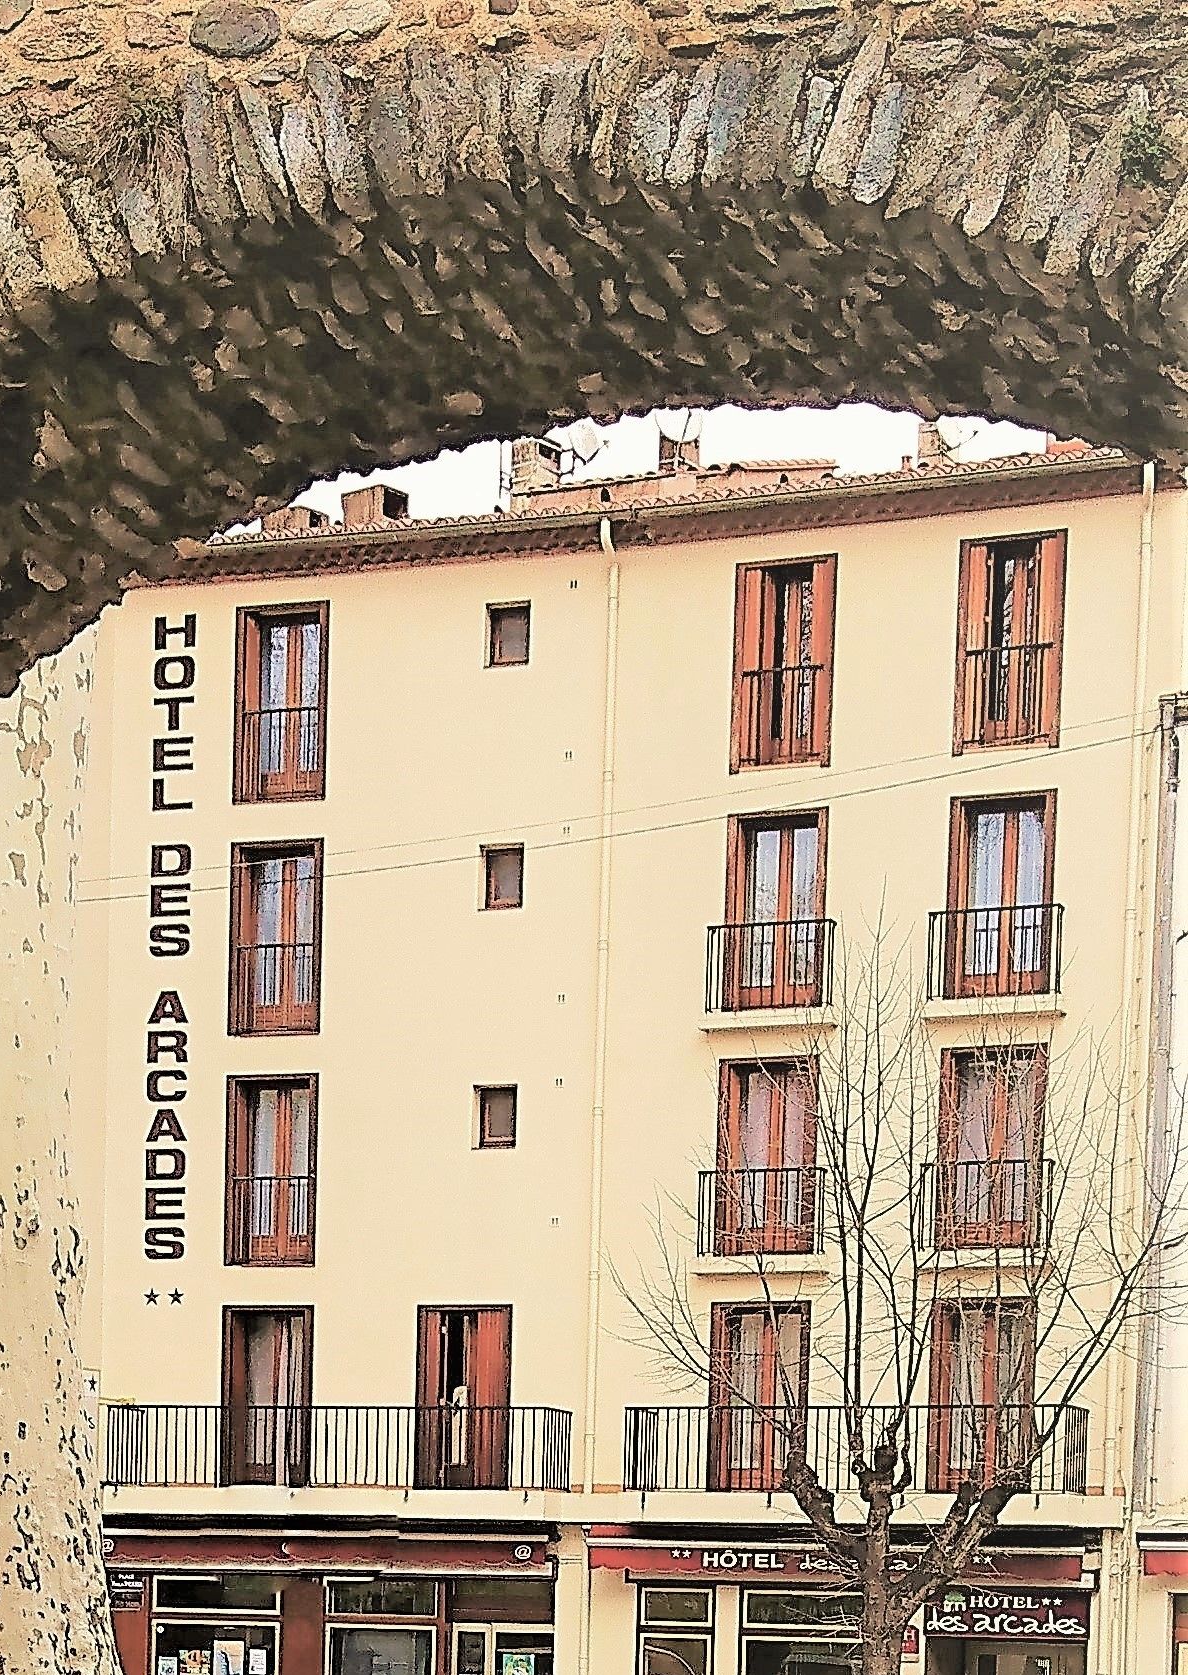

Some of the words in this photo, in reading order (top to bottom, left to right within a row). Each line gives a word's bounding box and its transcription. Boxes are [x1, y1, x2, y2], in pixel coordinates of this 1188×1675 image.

[152, 613, 197, 811] HOTEL
[149, 843, 192, 957] DES
[144, 989, 189, 1260] ARCADES
[702, 1549, 785, 1569] HÔTEL
[926, 1606, 969, 1632] des
[972, 1609, 1087, 1635] arcades
